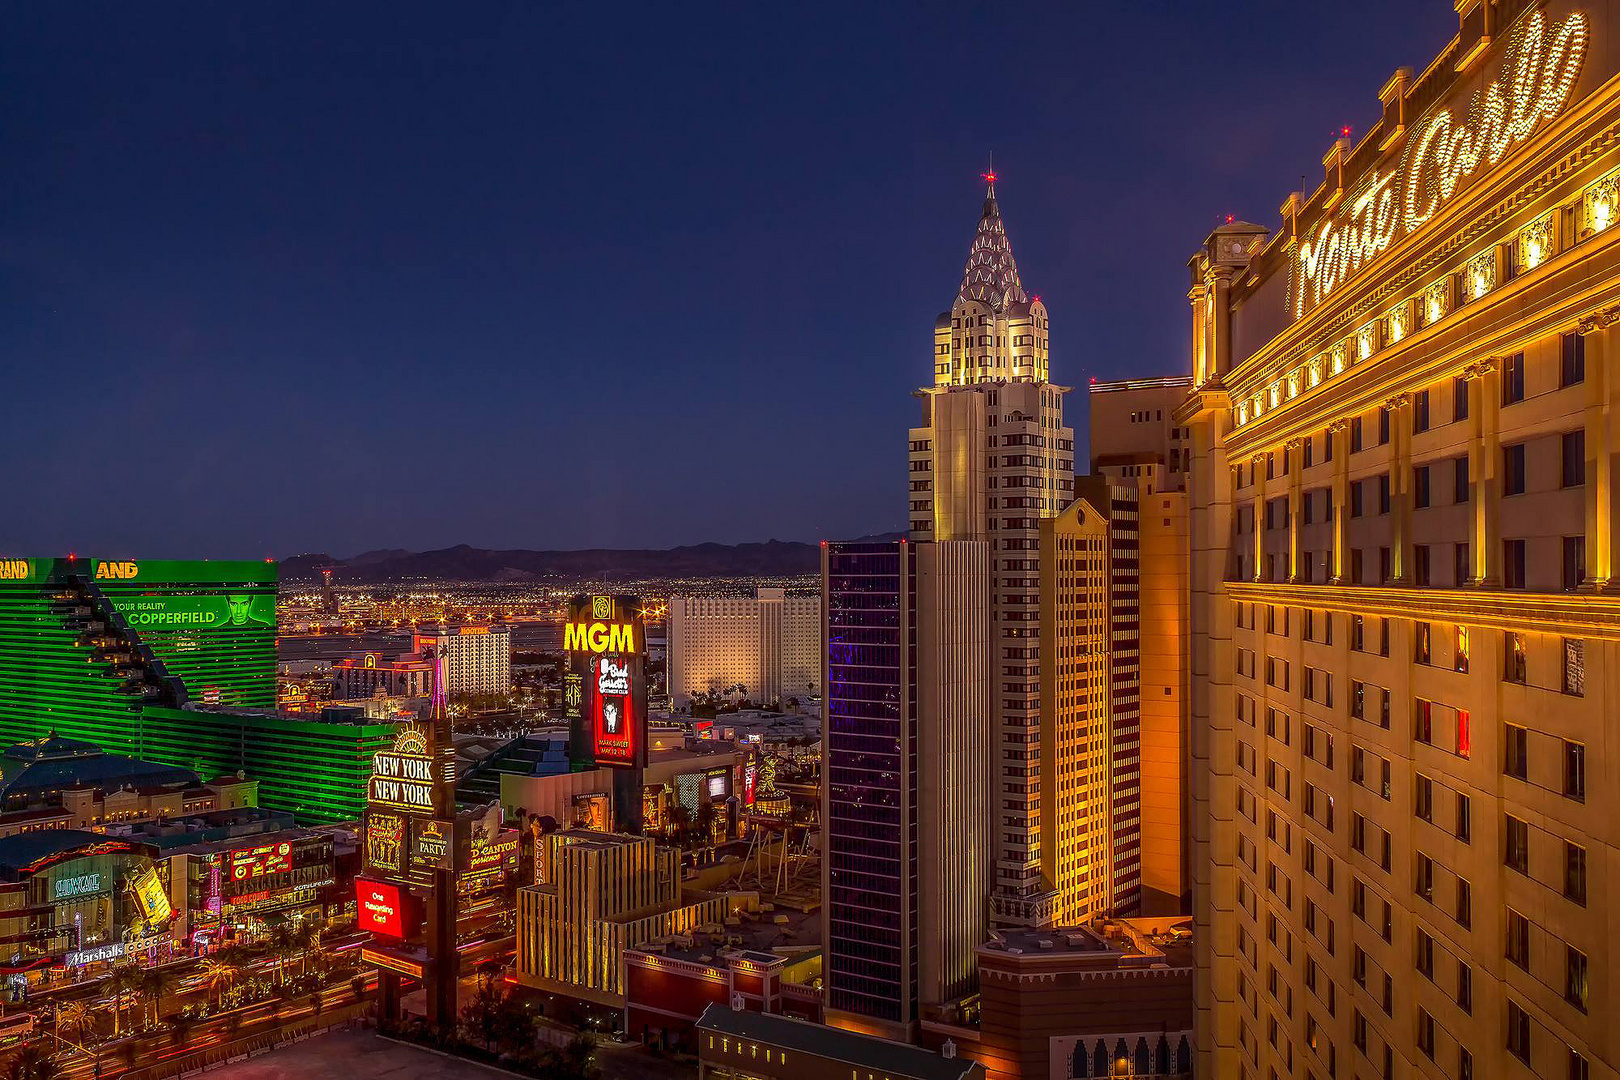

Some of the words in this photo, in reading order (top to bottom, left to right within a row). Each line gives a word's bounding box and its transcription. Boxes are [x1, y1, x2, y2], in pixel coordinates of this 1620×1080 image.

[114, 602, 136, 611] YOUR
[137, 602, 166, 611] REALITY
[128, 611, 215, 625] COPPERFIELD
[563, 622, 635, 653] MGM
[375, 755, 399, 777] NEW
[401, 758, 433, 780] YORK
[374, 780, 399, 801] NEW
[401, 783, 433, 806] YORK
[420, 842, 447, 856] PARTY.
[482, 840, 518, 855] CANYON
[55, 873, 101, 898] SHOWCASE
[372, 892, 384, 902] One
[373, 914, 386, 923] Card
[67, 943, 123, 971] Marshalls
